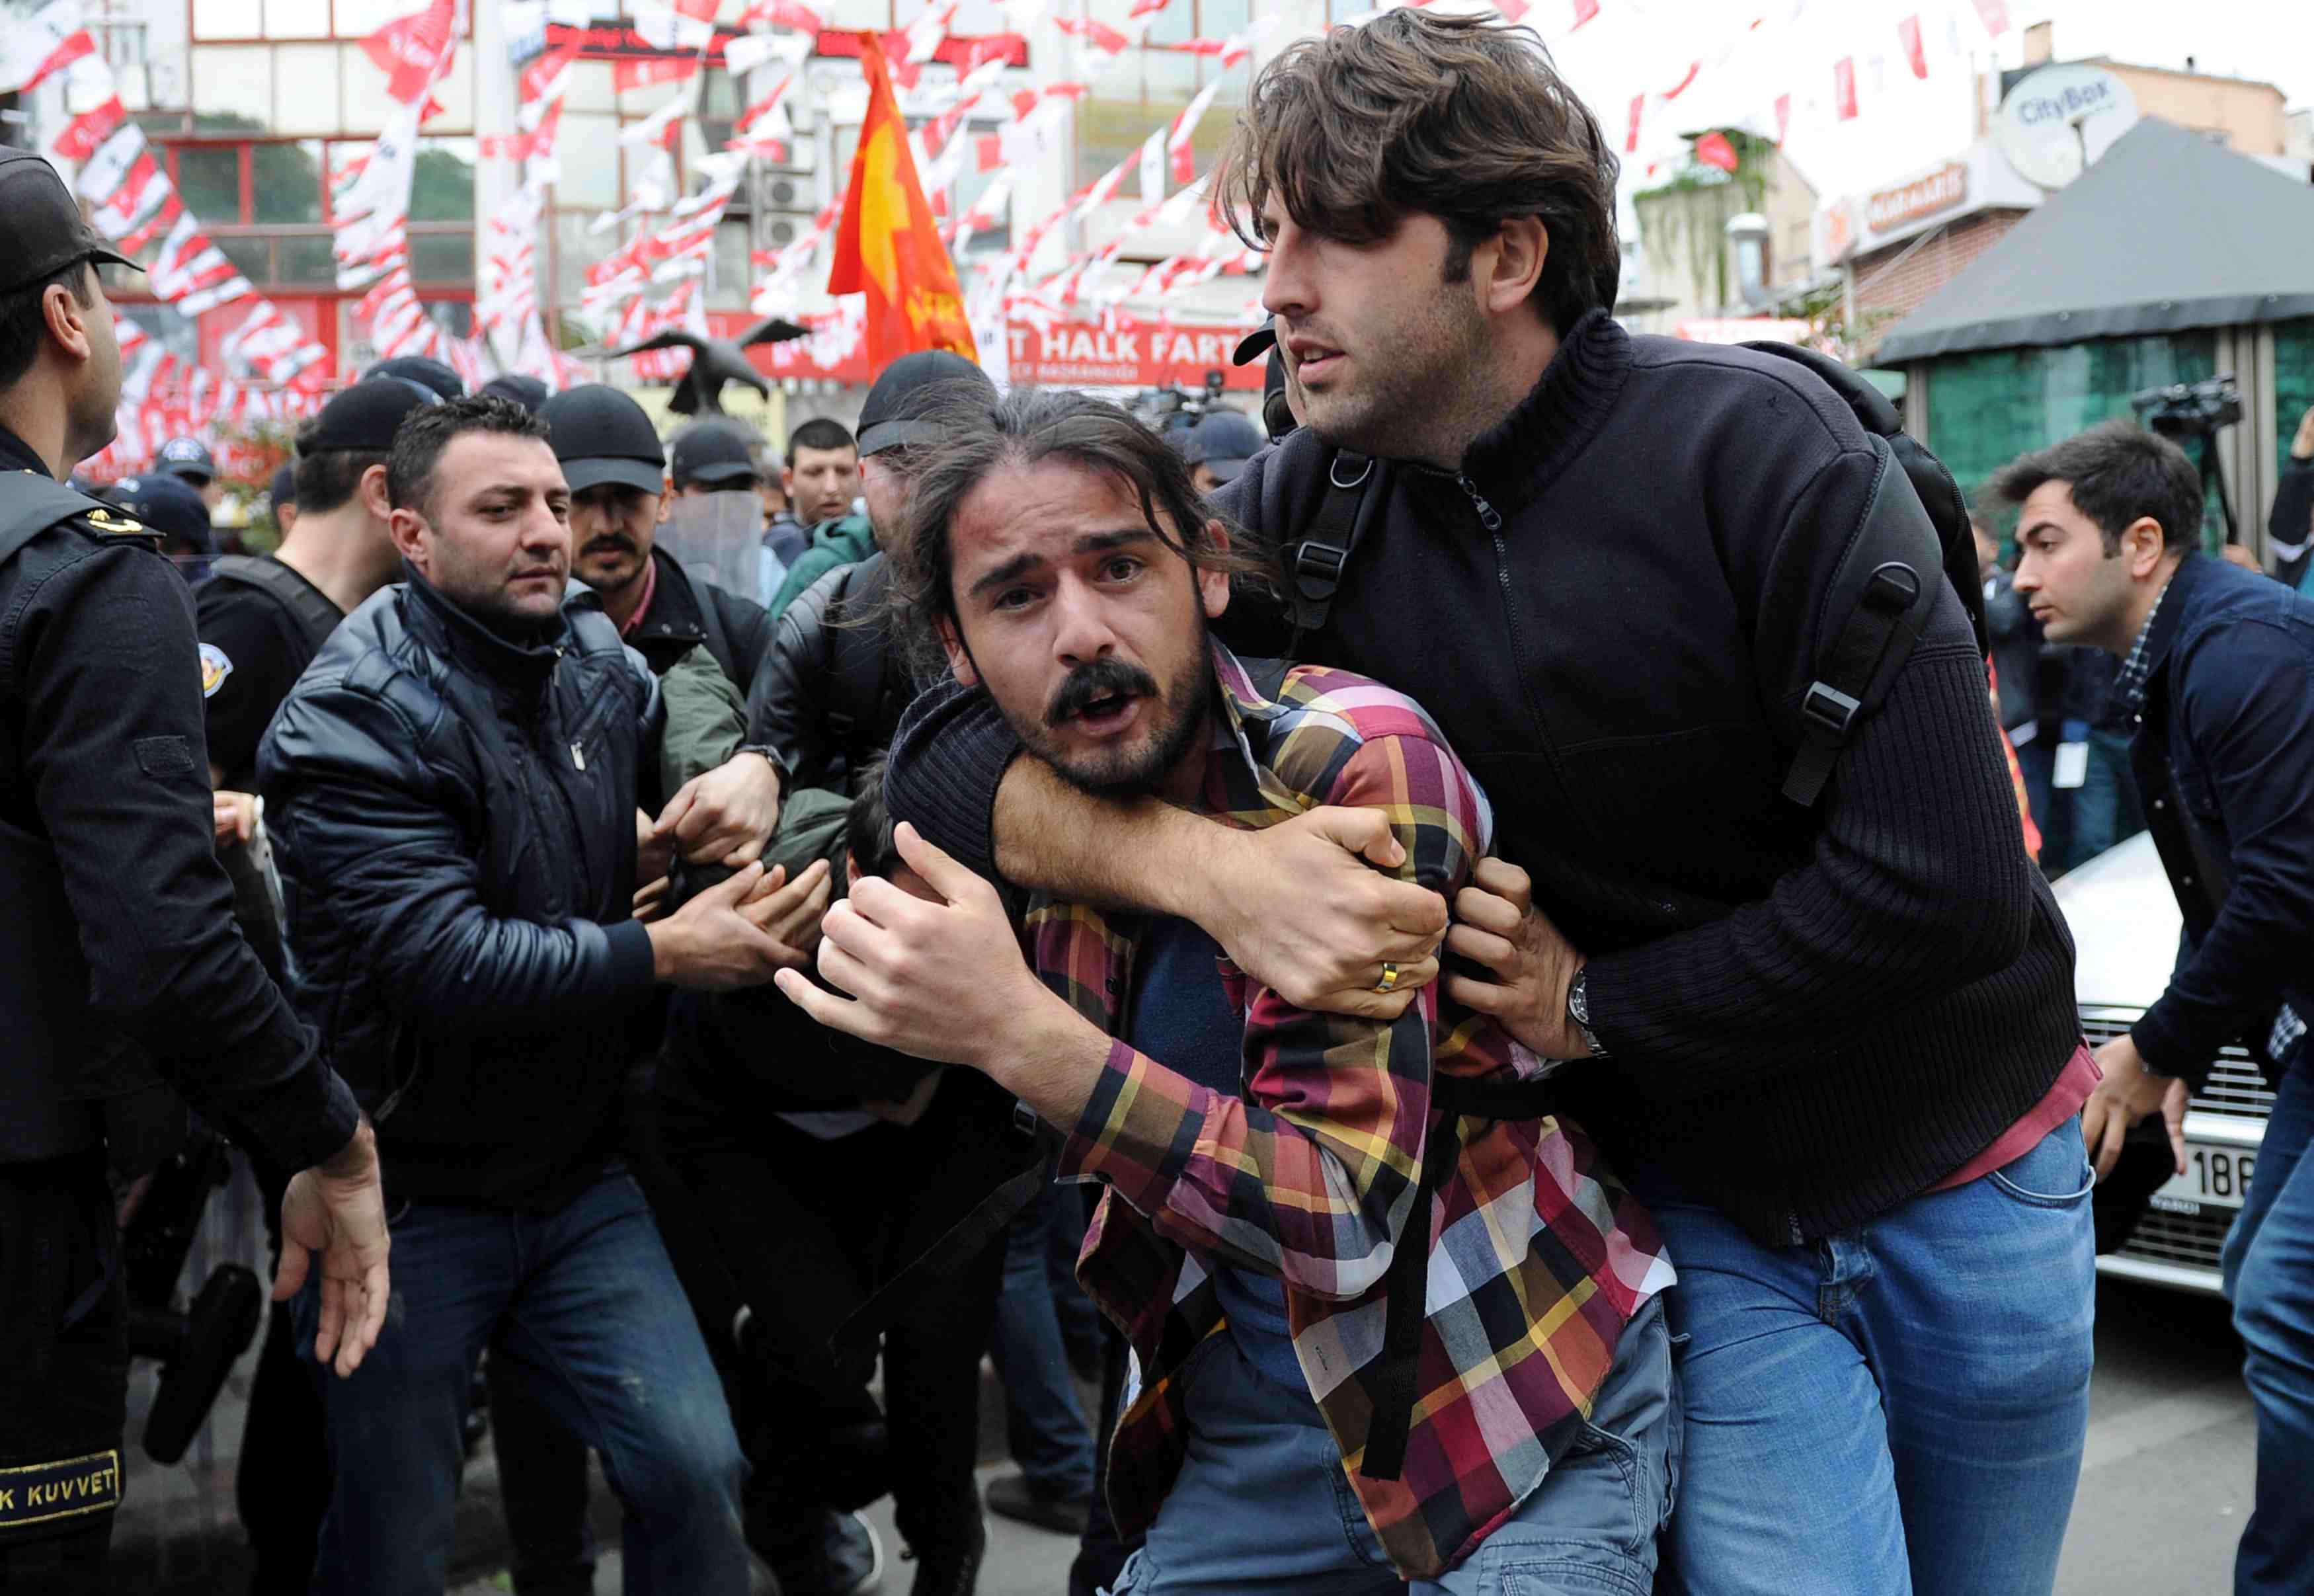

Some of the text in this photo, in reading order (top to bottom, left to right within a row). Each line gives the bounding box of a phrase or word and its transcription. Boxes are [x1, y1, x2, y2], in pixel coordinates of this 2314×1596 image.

[2019, 79, 2110, 126] CityBox
[1041, 328, 1140, 361] HALK
[0, 1468, 114, 1511] K KUVVET
